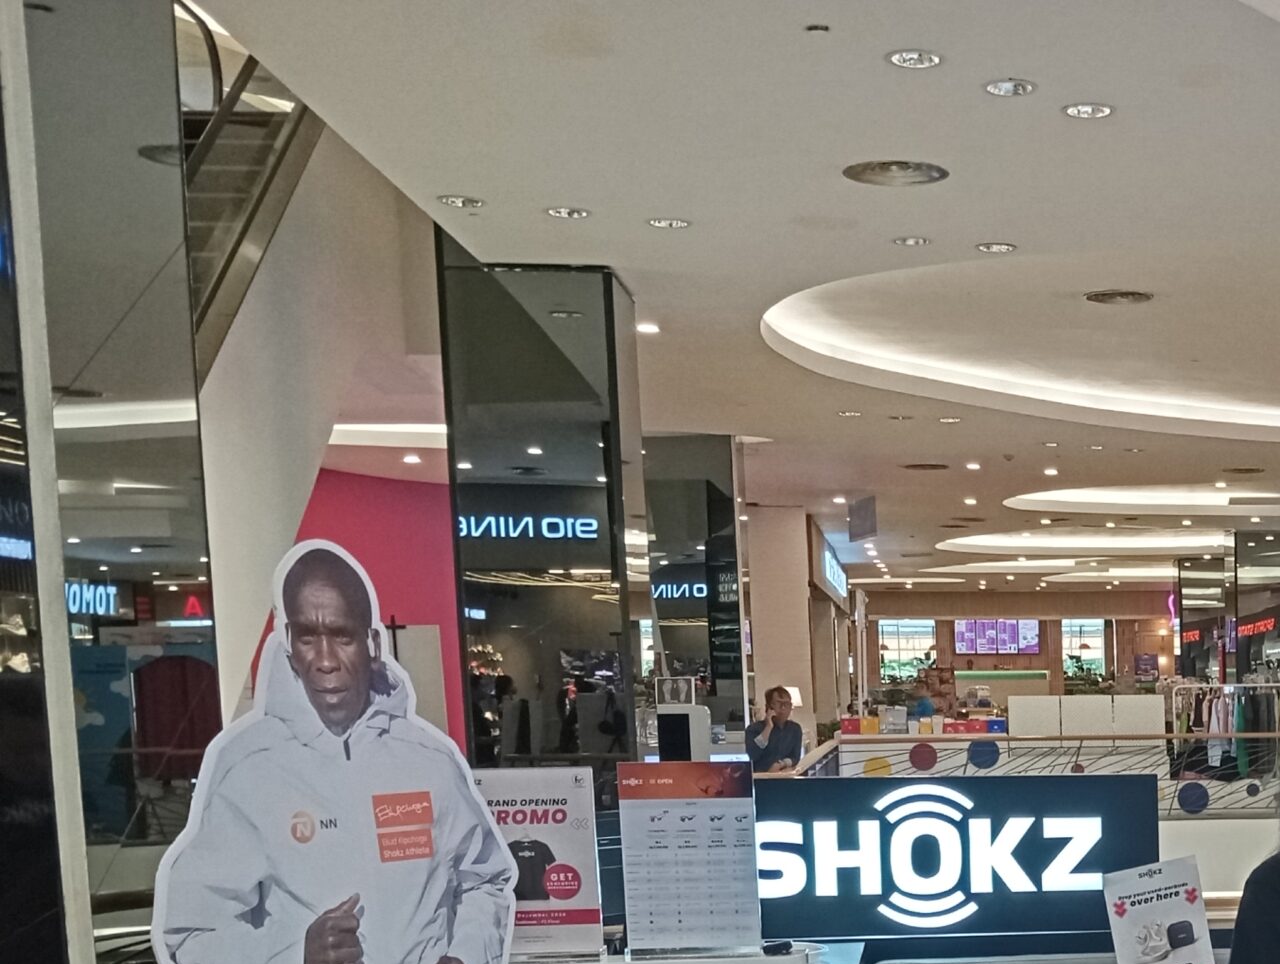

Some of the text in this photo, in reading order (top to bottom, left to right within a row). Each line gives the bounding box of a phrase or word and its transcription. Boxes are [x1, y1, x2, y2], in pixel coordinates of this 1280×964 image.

[486, 798, 568, 807] RAND OPENING
[319, 818, 338, 829] NN
[493, 808, 568, 825] ROMO
[755, 816, 1104, 898] SHOKZ
[550, 873, 573, 881] GET
[1130, 890, 1180, 907] over here
